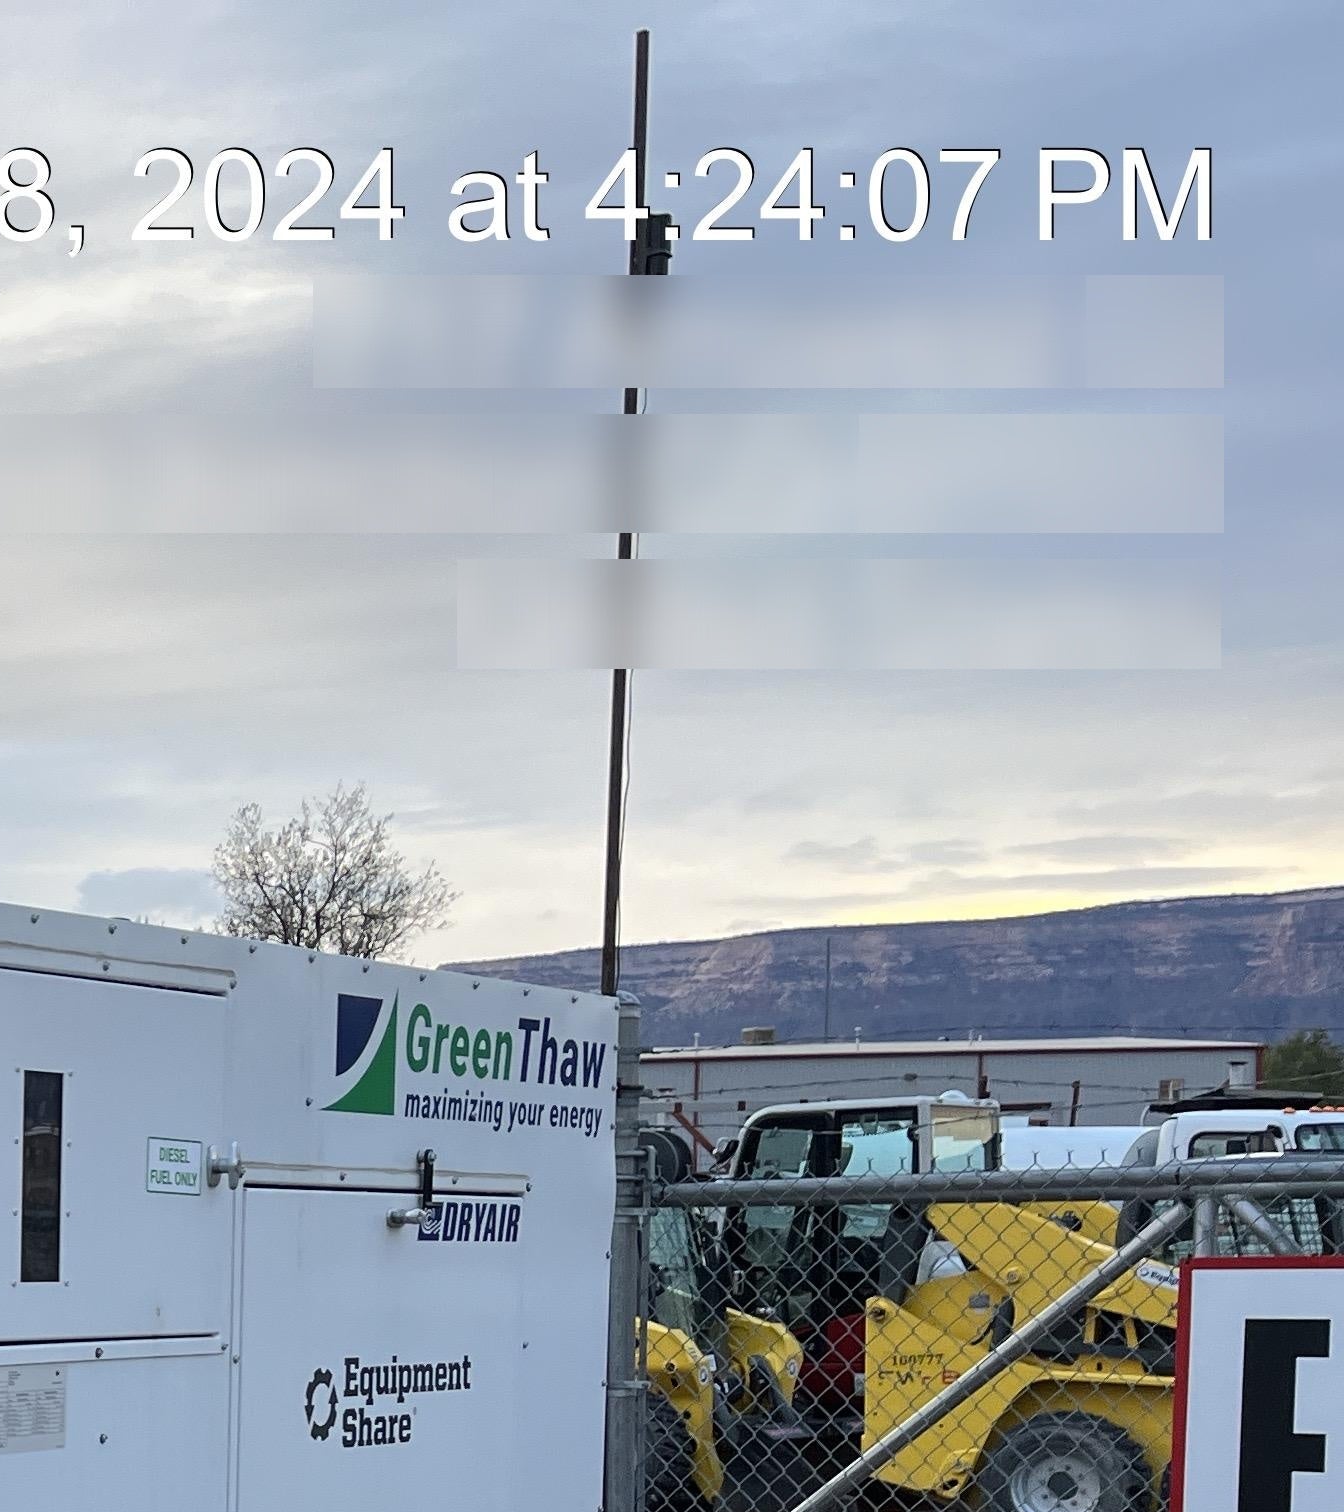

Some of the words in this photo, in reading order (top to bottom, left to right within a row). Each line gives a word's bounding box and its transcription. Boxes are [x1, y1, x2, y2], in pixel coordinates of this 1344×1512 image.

[406, 1003, 606, 1089] GreenThaw
[404, 1087, 504, 1132] maximizing
[507, 1101, 545, 1133] your
[549, 1104, 603, 1138] energy
[159, 1146, 191, 1164] DIESEL
[150, 1169, 173, 1185] FUEL
[175, 1171, 198, 1187] ONLY
[441, 1202, 521, 1242] DRYAIR
[343, 1355, 472, 1406] Equipment
[342, 1407, 412, 1448] Share
